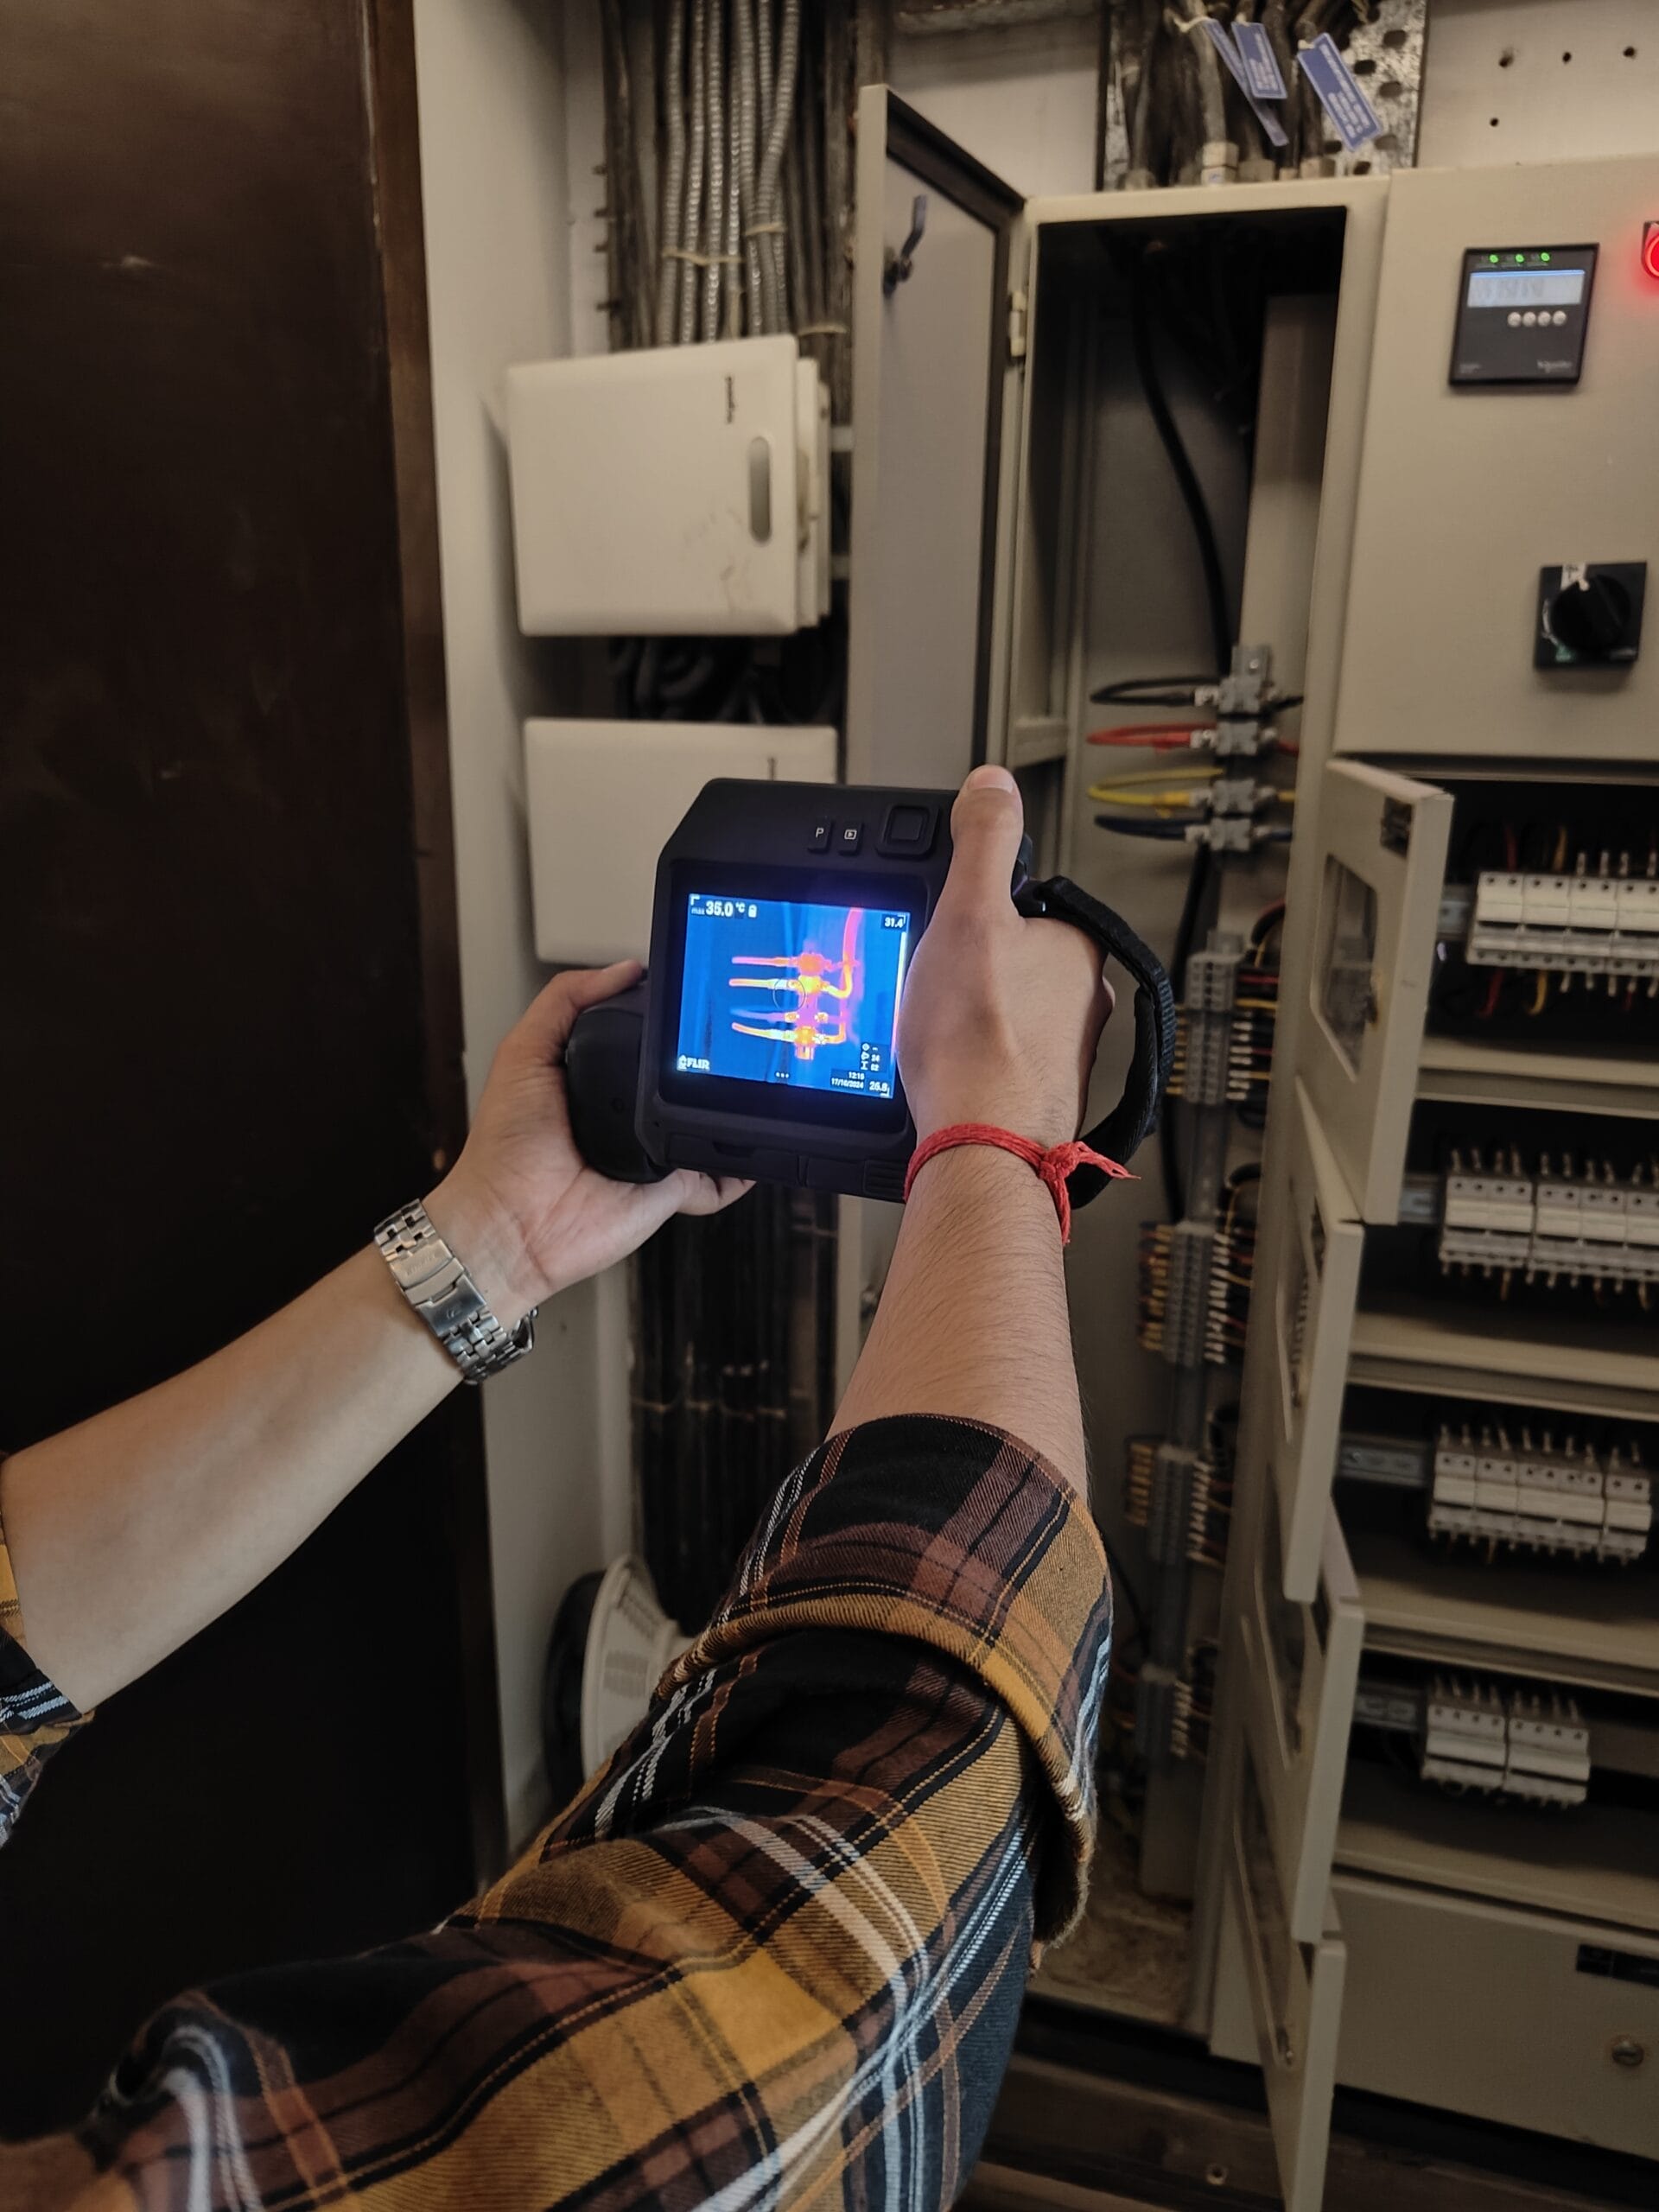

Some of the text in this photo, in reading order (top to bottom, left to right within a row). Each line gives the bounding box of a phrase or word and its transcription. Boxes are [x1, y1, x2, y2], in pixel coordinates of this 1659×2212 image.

[815, 827, 825, 838] P
[884, 917, 904, 928] 31.4
[687, 1057, 710, 1070] FLIR
